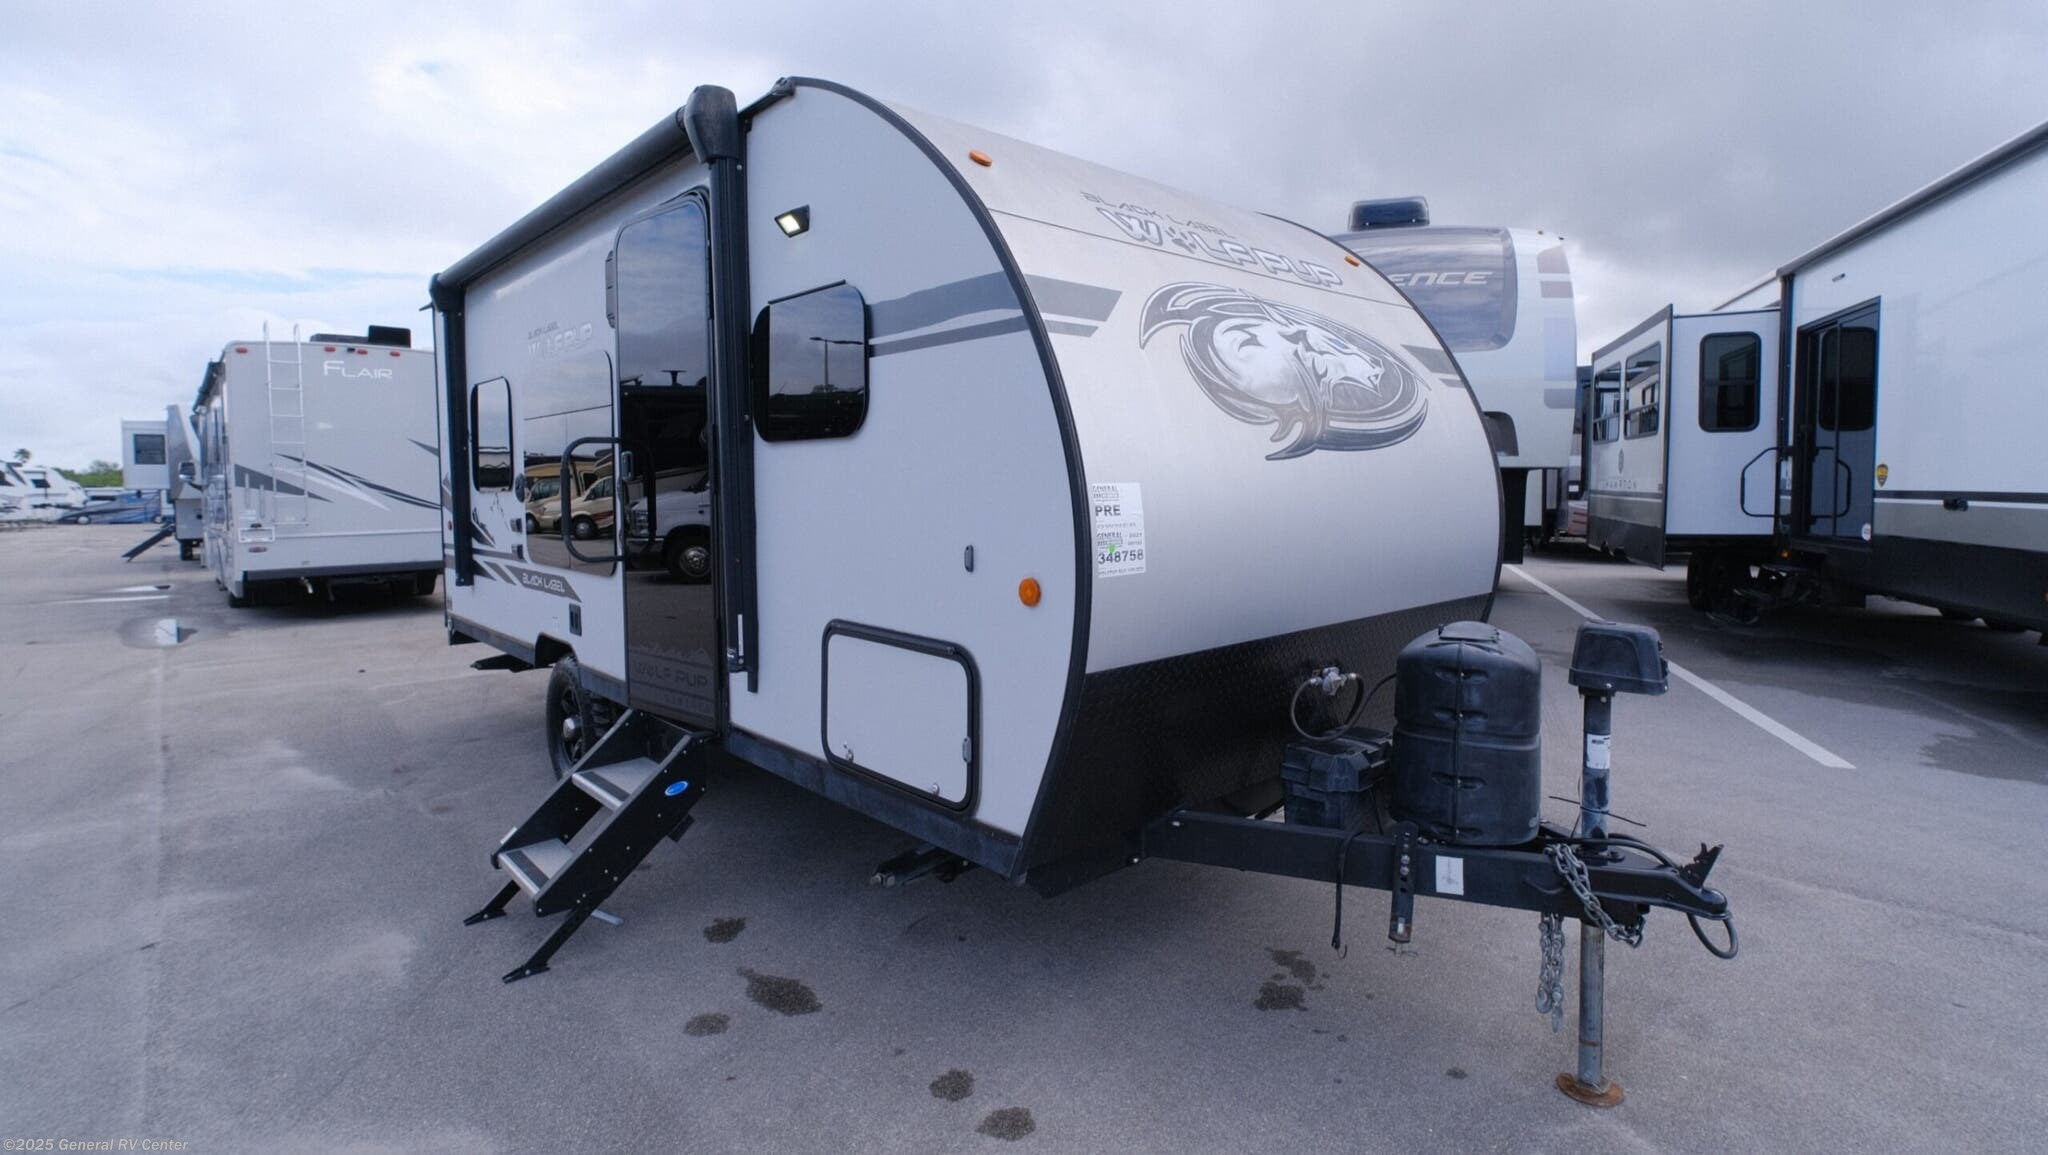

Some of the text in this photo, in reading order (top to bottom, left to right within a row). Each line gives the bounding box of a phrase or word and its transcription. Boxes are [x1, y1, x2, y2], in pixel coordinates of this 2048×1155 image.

[1251, 247, 1344, 288] PUP
[323, 360, 393, 379] FLAIR
[1095, 504, 1121, 517] PRE
[1098, 549, 1144, 565] 348758
